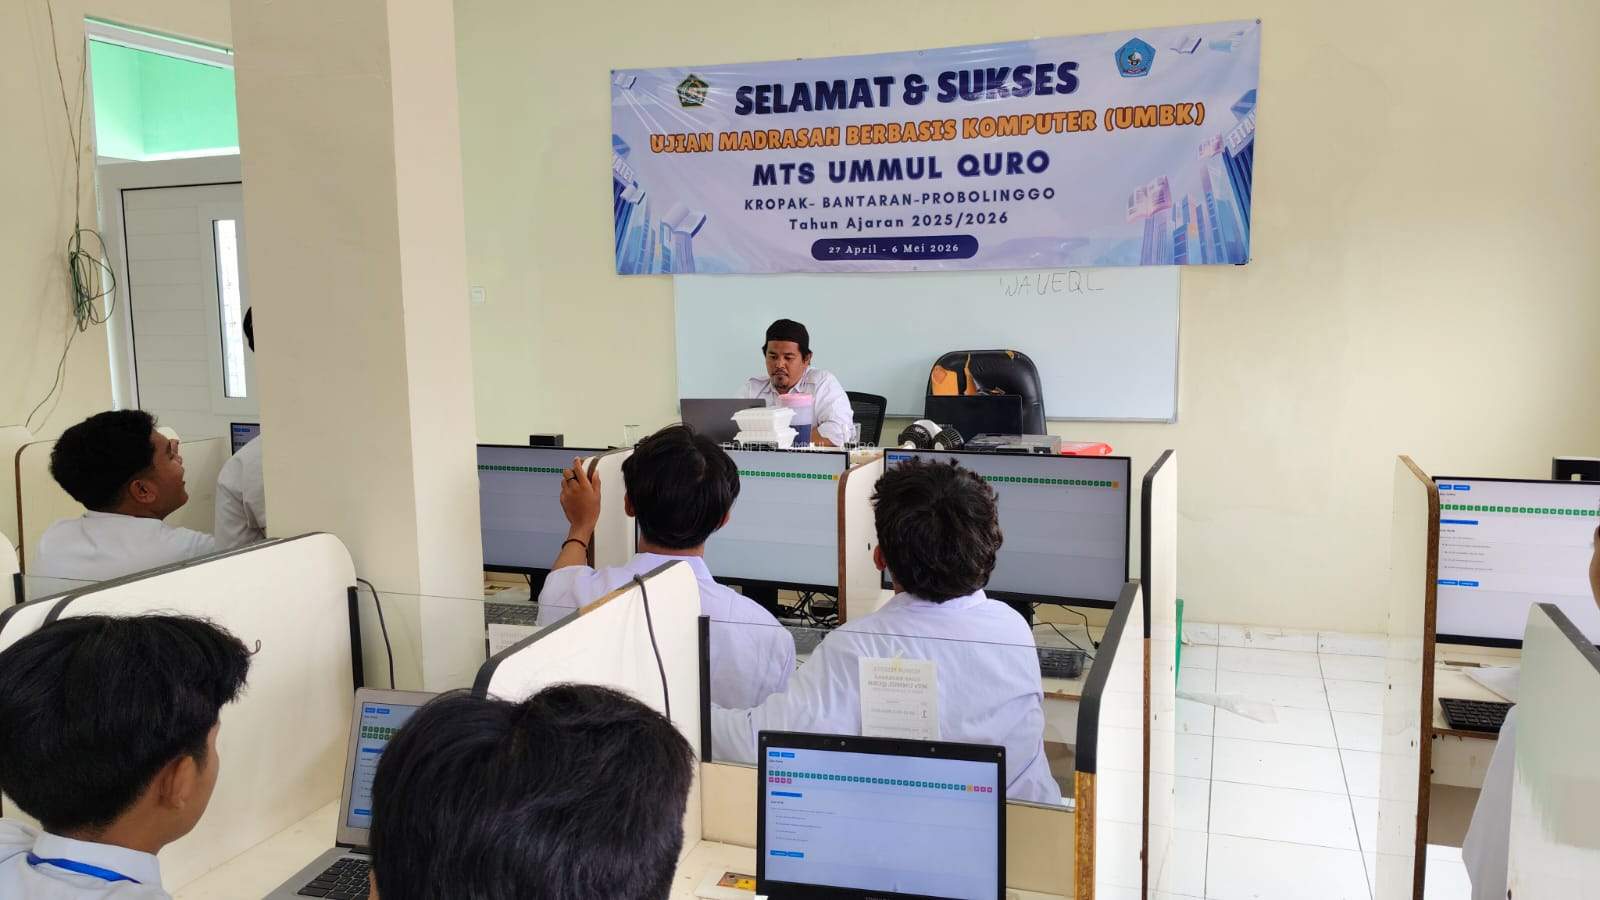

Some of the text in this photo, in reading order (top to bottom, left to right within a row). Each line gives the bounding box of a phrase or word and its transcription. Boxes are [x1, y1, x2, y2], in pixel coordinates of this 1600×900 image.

[735, 61, 1080, 115] SELAMAT & SUKSES
[650, 133, 714, 153] UJIAN
[718, 126, 840, 150] MADRASAH
[845, 119, 957, 146] BERBASIS
[962, 110, 1098, 139] KOMPUTER
[1104, 102, 1206, 131] (UMBK)
[752, 149, 1051, 186] MTS UMMUL QURO
[744, 187, 1055, 211] KROPAK- BANTARAN-PROBOLINGGO
[789, 211, 1009, 232] Tahun Ajaran 2025/2026
[828, 245, 842, 254] 27
[846, 244, 878, 257] April
[891, 244, 899, 254] 6
[902, 243, 927, 254] Mei
[930, 243, 960, 253] 2026
